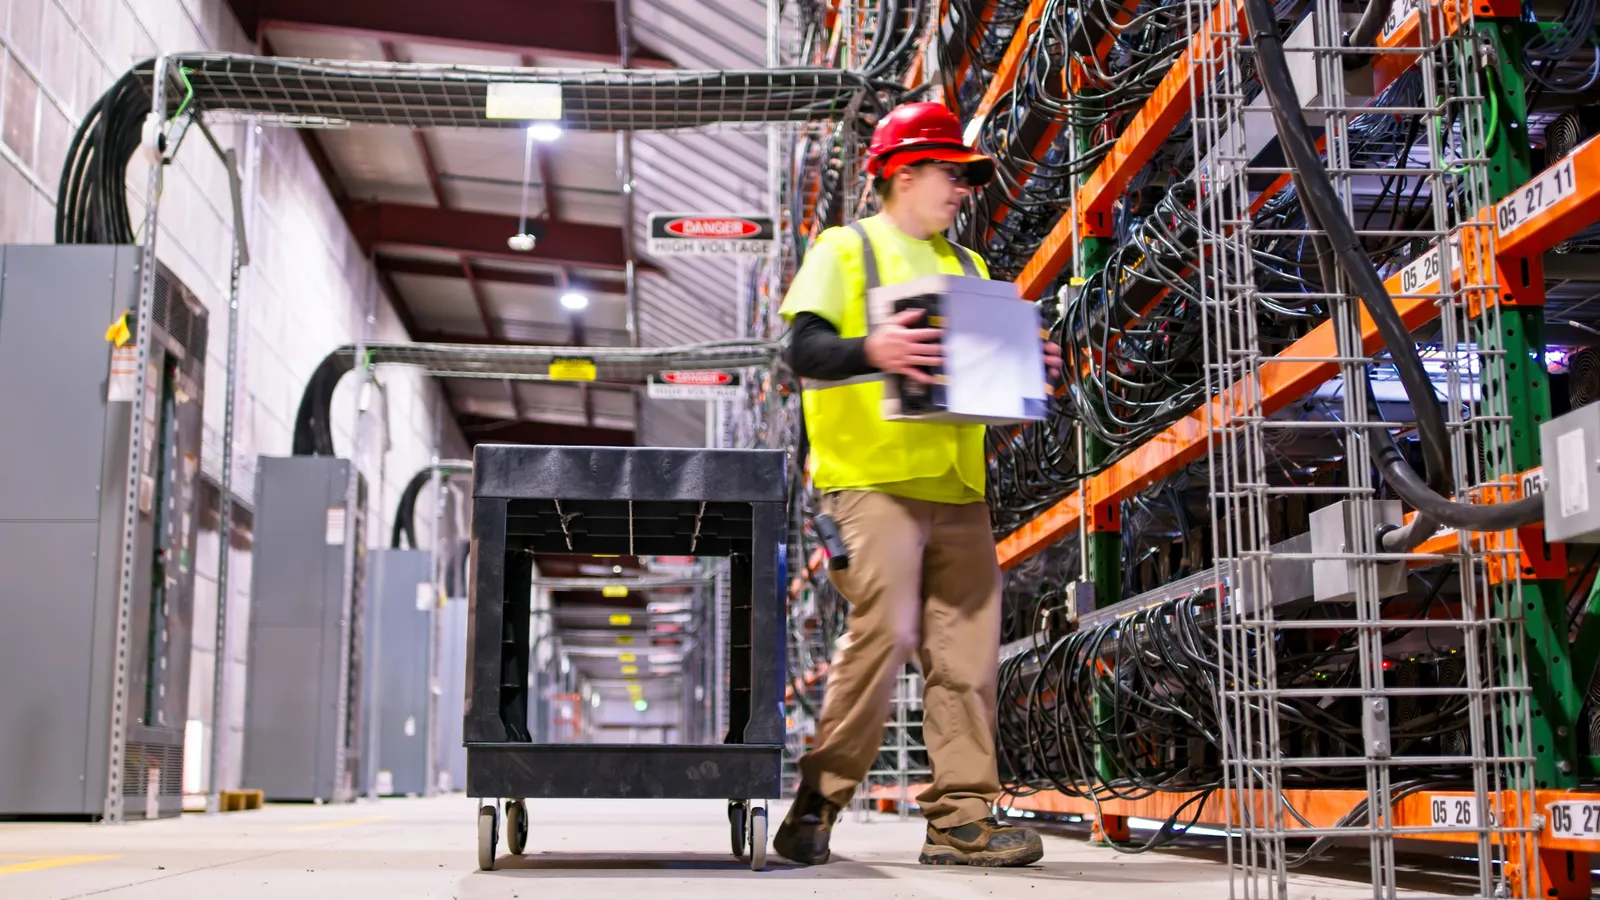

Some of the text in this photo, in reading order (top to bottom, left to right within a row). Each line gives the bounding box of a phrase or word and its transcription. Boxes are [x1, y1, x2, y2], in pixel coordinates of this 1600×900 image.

[1499, 162, 1573, 231] 05_27_11
[682, 220, 743, 234] DANGER
[655, 241, 769, 253] HIGH VOLTAGE
[1552, 804, 1600, 836] 05_27
